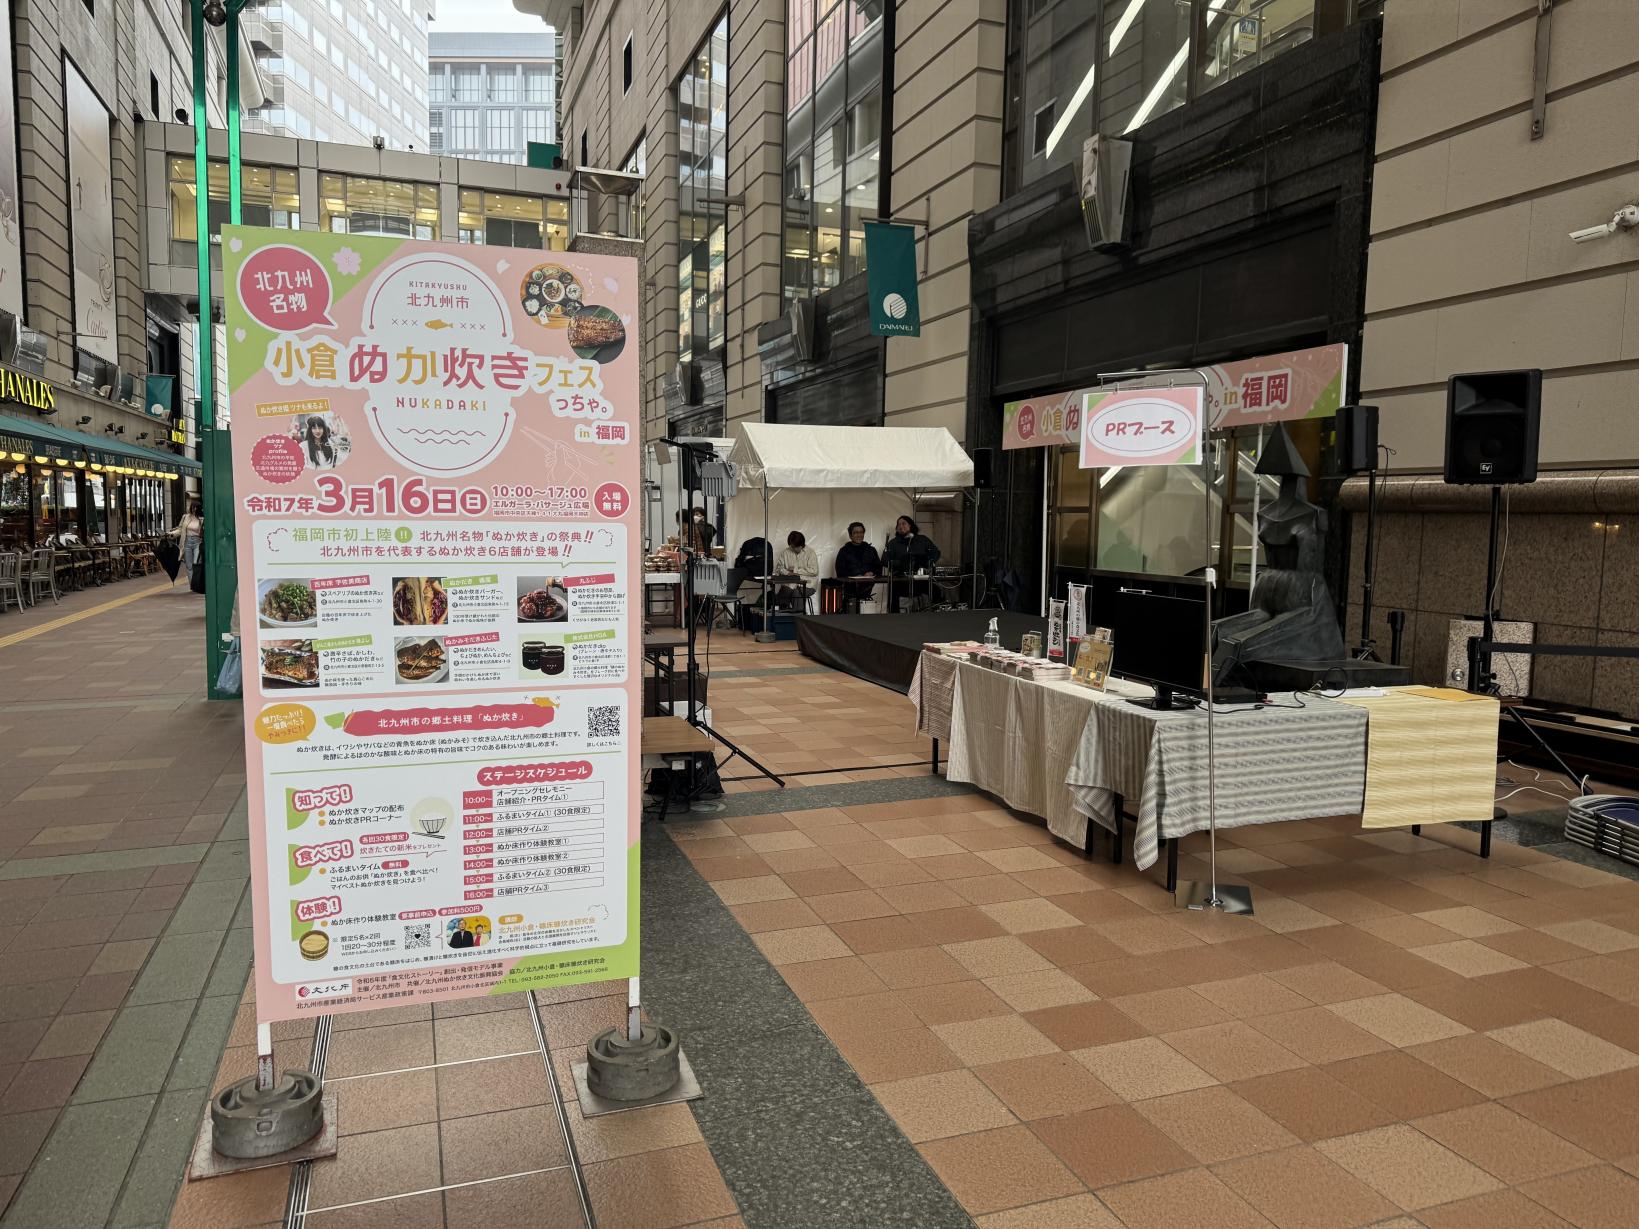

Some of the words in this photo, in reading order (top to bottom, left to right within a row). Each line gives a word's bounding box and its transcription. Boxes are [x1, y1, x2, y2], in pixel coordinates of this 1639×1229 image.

[254, 269, 313, 291] 北九州
[409, 281, 467, 290] KITAKYUSHU
[269, 292, 308, 314] 名物
[407, 293, 469, 309] 北九州市
[273, 340, 597, 390] 小倉ぬか炊きフェス
[1223, 387, 1238, 405] in
[1242, 372, 1289, 409] 福岡
[396, 397, 487, 411] NUKADAKI
[556, 394, 607, 414] っちゃ。
[580, 429, 590, 439] in
[596, 425, 626, 440] 福岡
[1105, 420, 1175, 437] PRブース
[247, 476, 457, 514] 令和7年3月16日
[492, 486, 587, 499] 10:00〜17:00
[602, 491, 622, 501] 入場
[493, 500, 590, 510] エルガーラ・パサージュ広場
[602, 501, 622, 511] 無料
[293, 527, 392, 542] 福岡市初上陸
[378, 713, 524, 729] 北九州市の郷土料理「ぬか炊き」
[483, 766, 588, 781] ステージスケジュール
[496, 786, 573, 797] オープニングセレモニー
[329, 804, 405, 817] ぬか炊きマップの配布
[329, 814, 402, 826] ぬか炊きPRコーナー
[330, 863, 381, 874] ふるまいタイム
[330, 914, 397, 926] ぬか床作り体験教室
[312, 983, 350, 995] 文化庁
